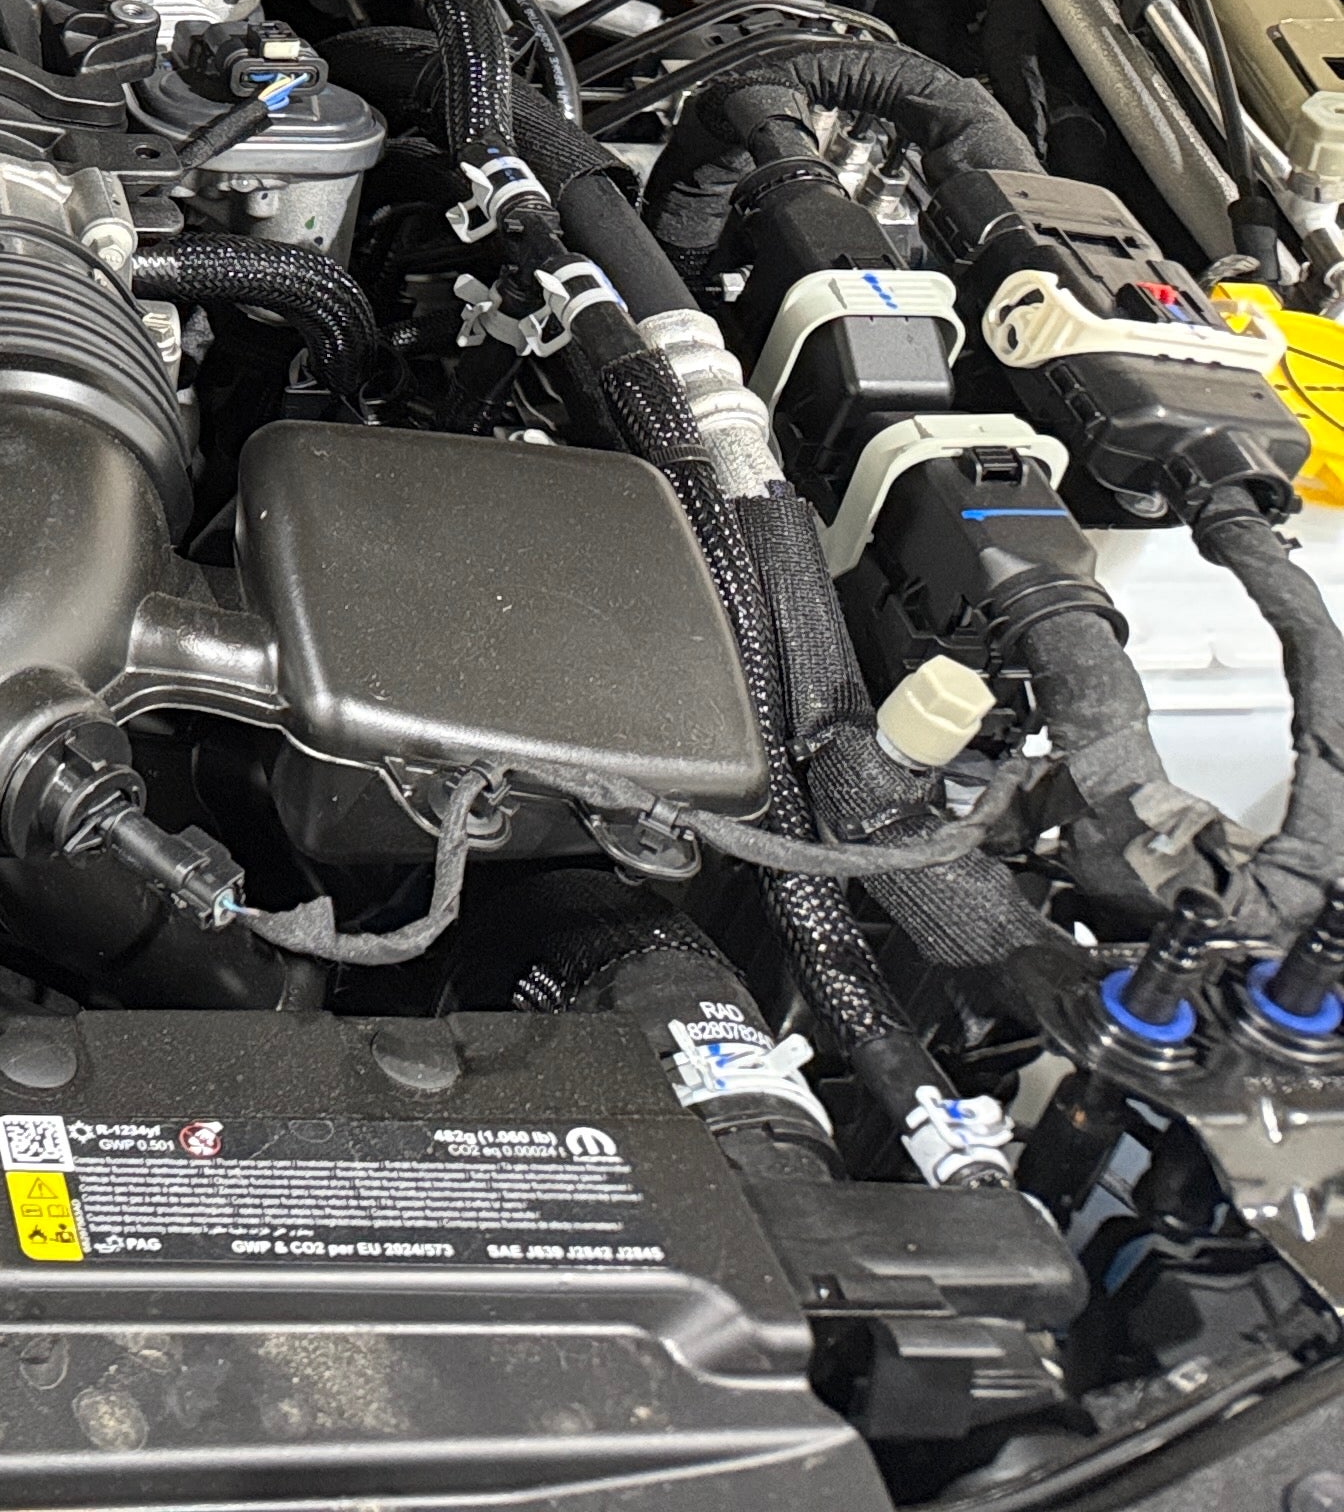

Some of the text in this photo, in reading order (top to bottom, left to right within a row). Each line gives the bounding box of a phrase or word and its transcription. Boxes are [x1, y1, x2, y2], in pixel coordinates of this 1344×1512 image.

[699, 1001, 746, 1023] RAD
[95, 1123, 161, 1139] R-1234yf
[531, 1131, 558, 1147] lb)
[98, 1138, 176, 1152] GWP 0.501
[447, 1143, 481, 1157] CO2
[482, 1146, 503, 1159] eq
[125, 1237, 163, 1252] PAG
[231, 1240, 271, 1255] GWP
[289, 1241, 326, 1256] CO2
[327, 1243, 355, 1258] per
[356, 1241, 383, 1257] EU
[486, 1244, 524, 1259] SAE
